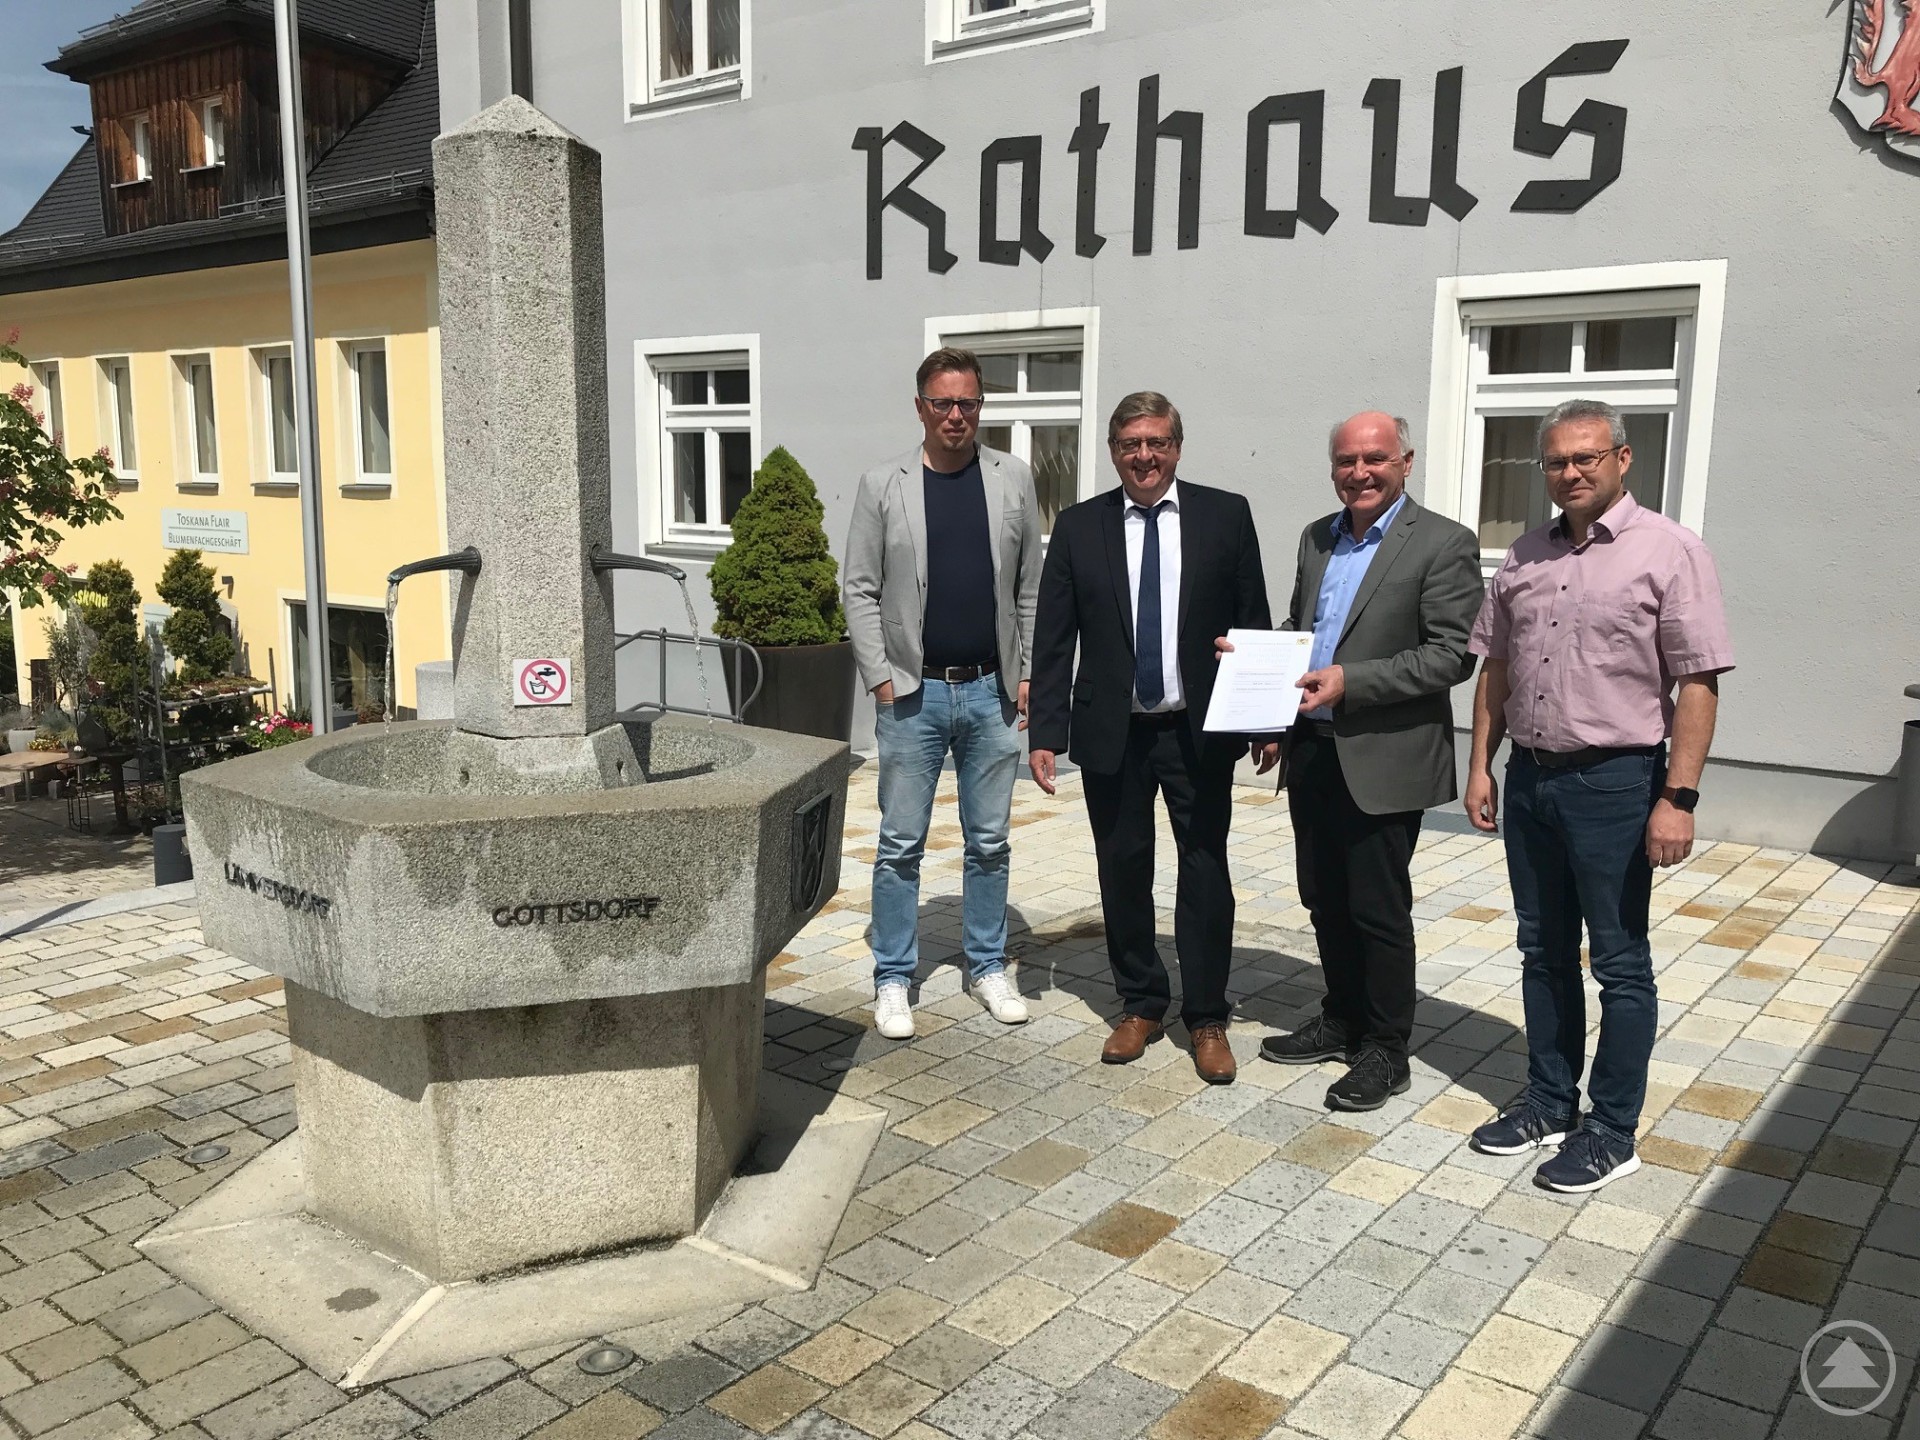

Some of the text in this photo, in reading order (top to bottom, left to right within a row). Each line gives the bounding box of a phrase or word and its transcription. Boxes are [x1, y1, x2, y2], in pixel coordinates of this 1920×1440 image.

[851, 38, 1630, 280] Rathaus
[177, 512, 230, 528] TOSKANA FLAIR
[168, 532, 241, 548] BLUMENFACHGESCHÄFT
[492, 896, 661, 928] GOTTSDORF
